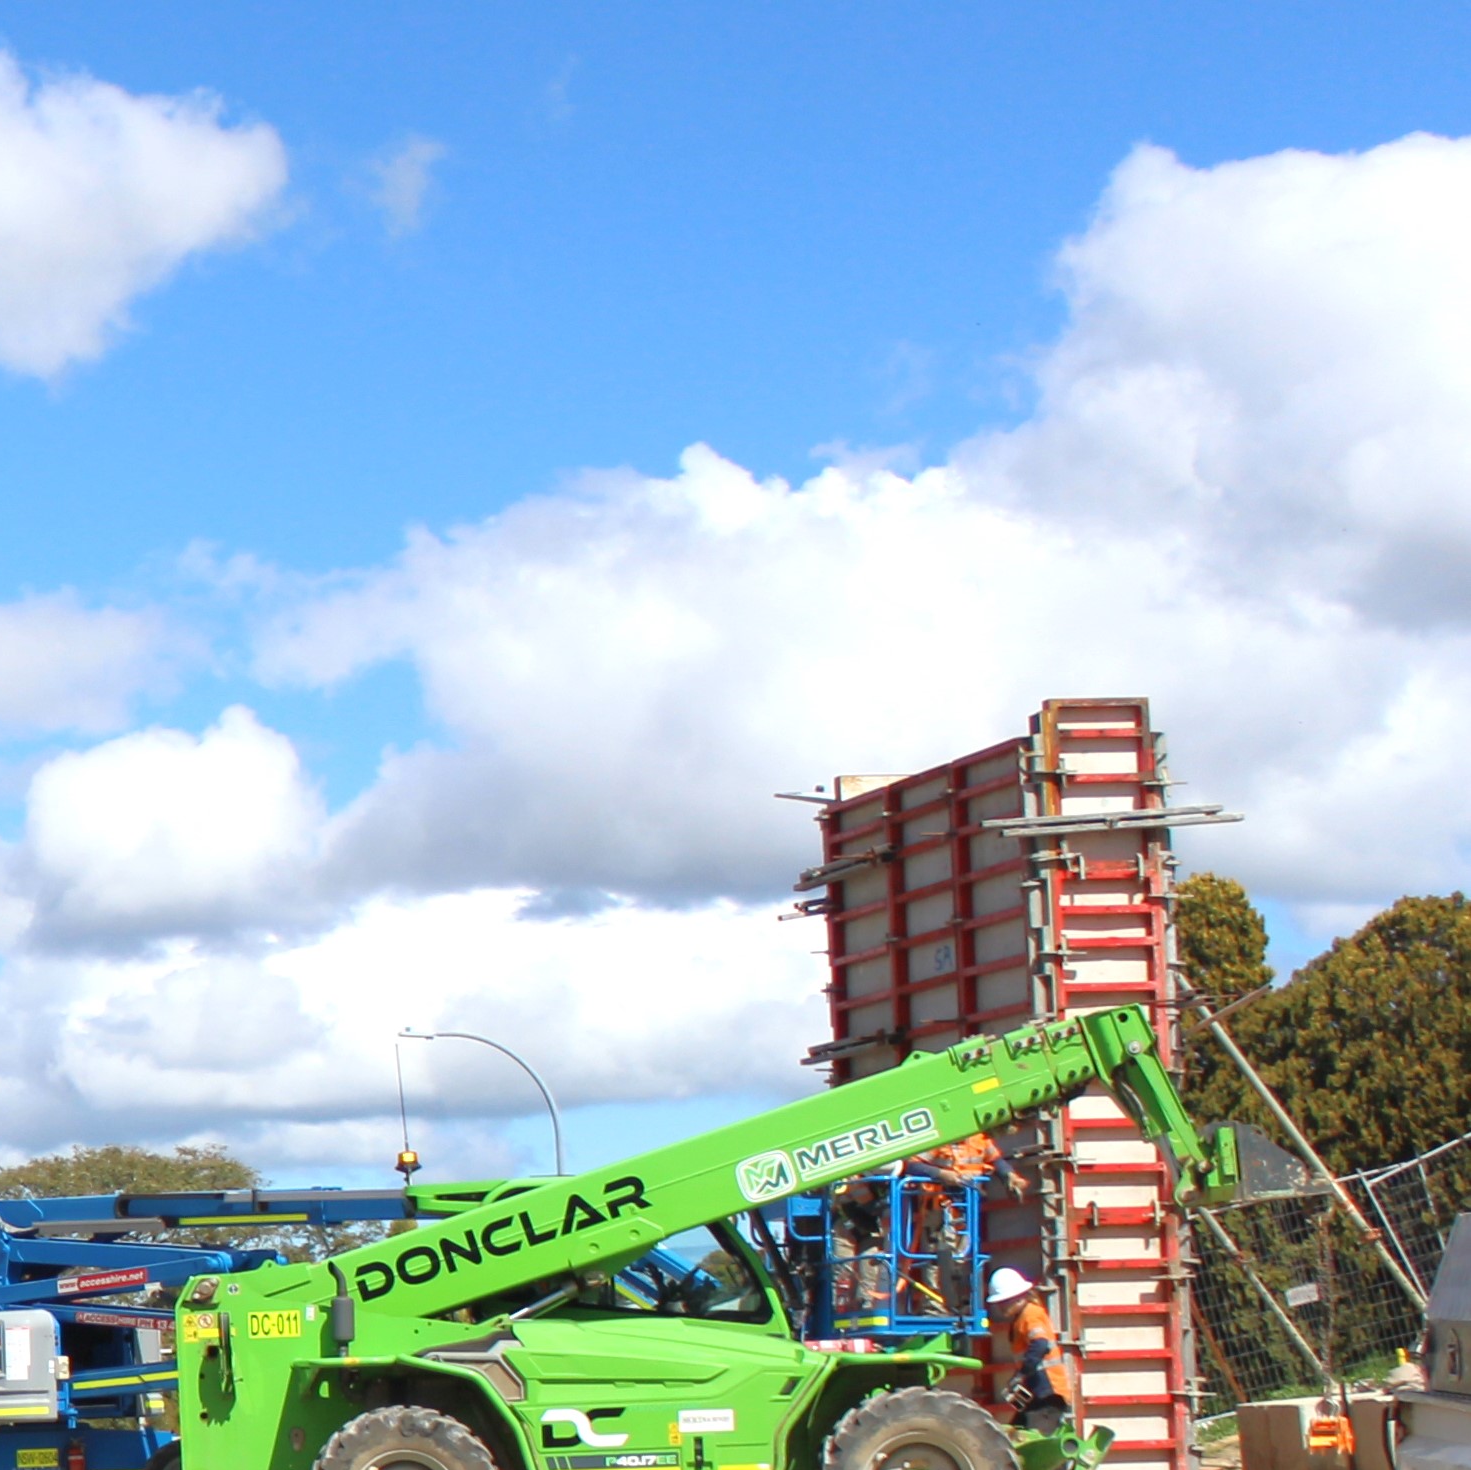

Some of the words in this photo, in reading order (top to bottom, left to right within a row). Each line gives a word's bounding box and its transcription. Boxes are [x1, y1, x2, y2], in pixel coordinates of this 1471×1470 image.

[795, 1109, 934, 1171] MERLO
[355, 1176, 653, 1302] DONCLAR
[79, 1271, 144, 1288] accesshire.net
[250, 1313, 299, 1336] DC-011
